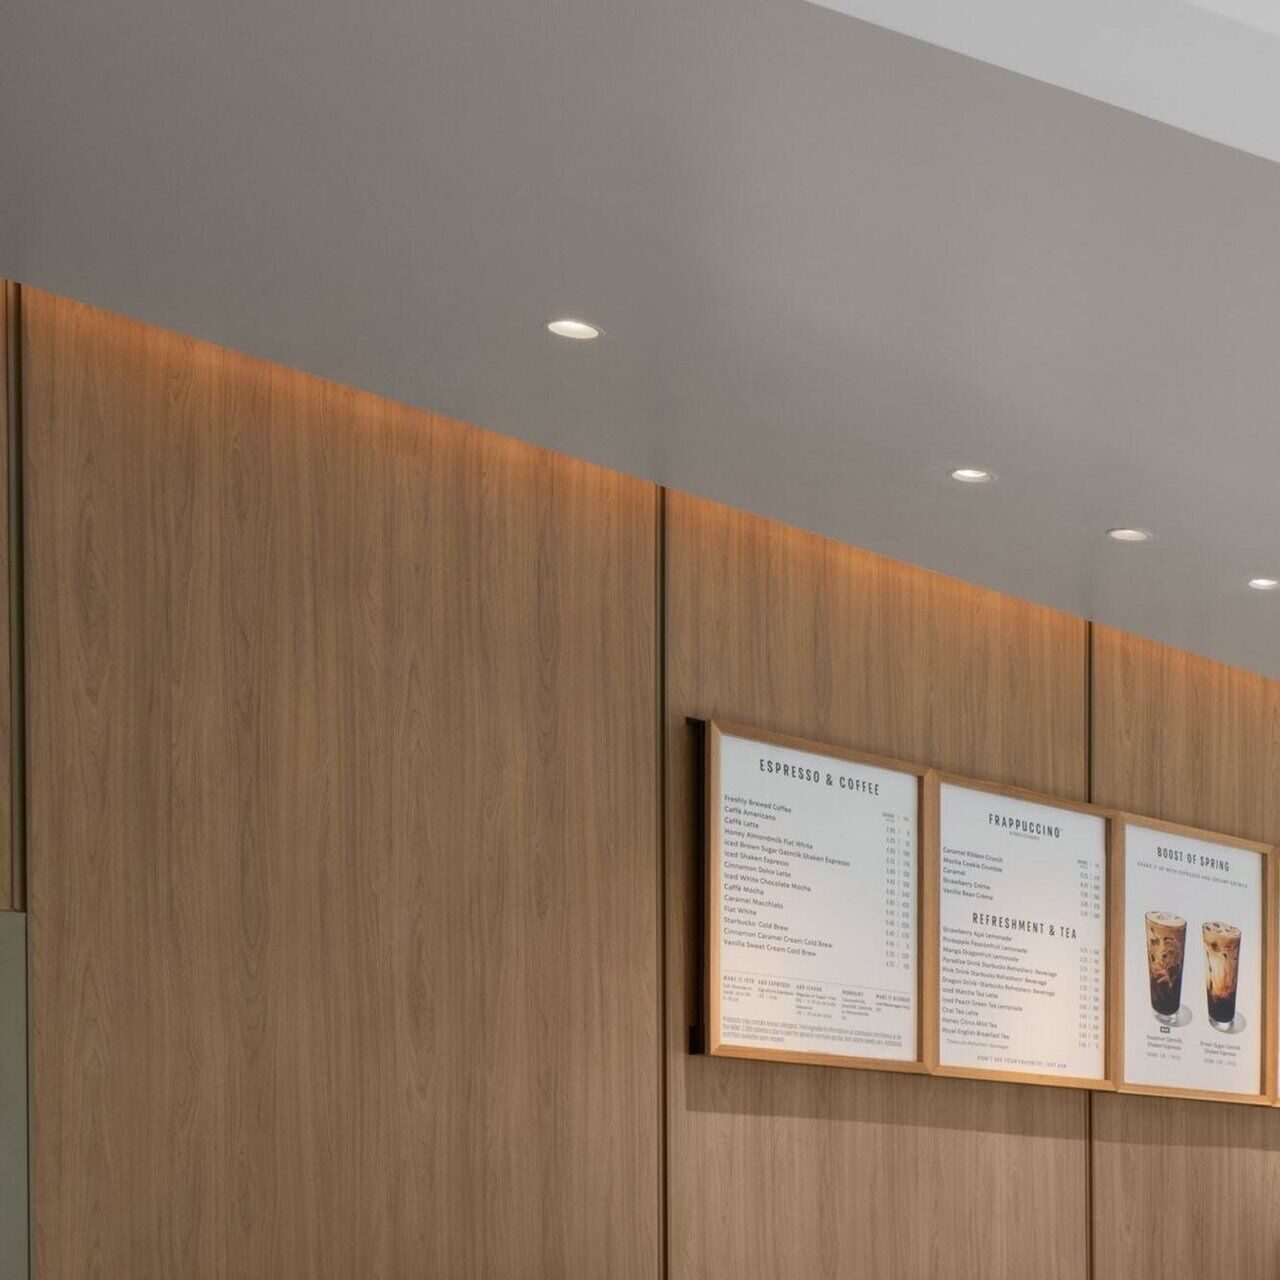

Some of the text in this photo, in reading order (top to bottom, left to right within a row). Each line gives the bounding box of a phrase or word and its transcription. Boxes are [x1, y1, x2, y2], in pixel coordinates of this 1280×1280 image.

[760, 759, 880, 796] ESPRESSO & COFFEE
[724, 795, 791, 813] Freshly Brewed Coffee
[744, 809, 776, 821] Americano
[744, 820, 759, 828] Latte
[989, 814, 1060, 838] FRAPPUCCINO
[724, 828, 745, 838] Honey
[795, 841, 813, 849] White
[724, 850, 789, 866] Iced Shaken Espresso
[740, 842, 760, 850] Brown
[761, 846, 777, 854] Sugar
[803, 853, 825, 861] Shaken
[826, 857, 850, 866] Espresso
[943, 847, 965, 856] Caramel
[1157, 847, 1230, 872] BOOST OF SPRING
[724, 861, 791, 877] Cinnamon Dolce Latte
[943, 867, 966, 875] Caramel
[963, 860, 980, 869] Cookie
[740, 875, 758, 883] White
[760, 878, 790, 889] Chocolate
[791, 883, 811, 892] Mocha
[743, 886, 764, 895] Mocha
[943, 877, 972, 888] Strawberry
[724, 895, 751, 903] Caramel
[738, 908, 756, 916] White
[758, 921, 772, 929] Cold
[973, 912, 1077, 940] REFRESHMENT & TEA
[724, 928, 756, 938] Cinnamon
[758, 932, 782, 940] Caramel
[784, 936, 802, 944] Cream
[724, 939, 745, 947] Vanilla
[747, 942, 765, 950] Sweet
[787, 947, 801, 955] Cold
